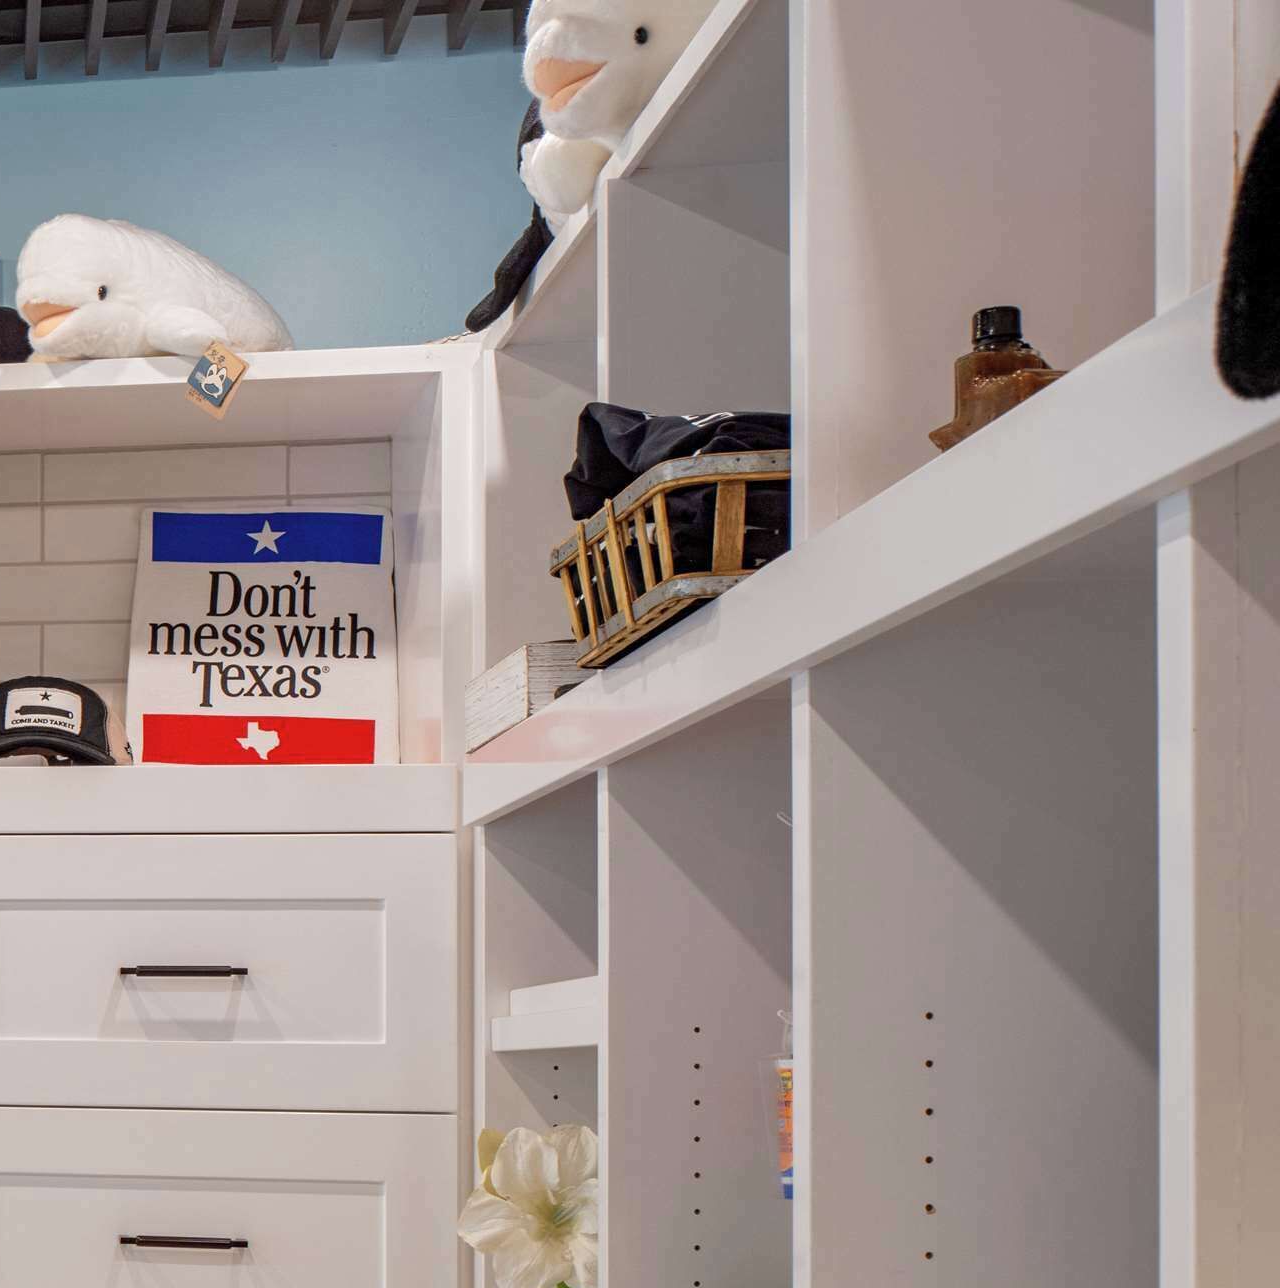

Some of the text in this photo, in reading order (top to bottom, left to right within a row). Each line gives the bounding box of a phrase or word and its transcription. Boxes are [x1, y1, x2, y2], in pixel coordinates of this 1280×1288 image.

[206, 570, 317, 618] Don't
[148, 613, 377, 660] mess with
